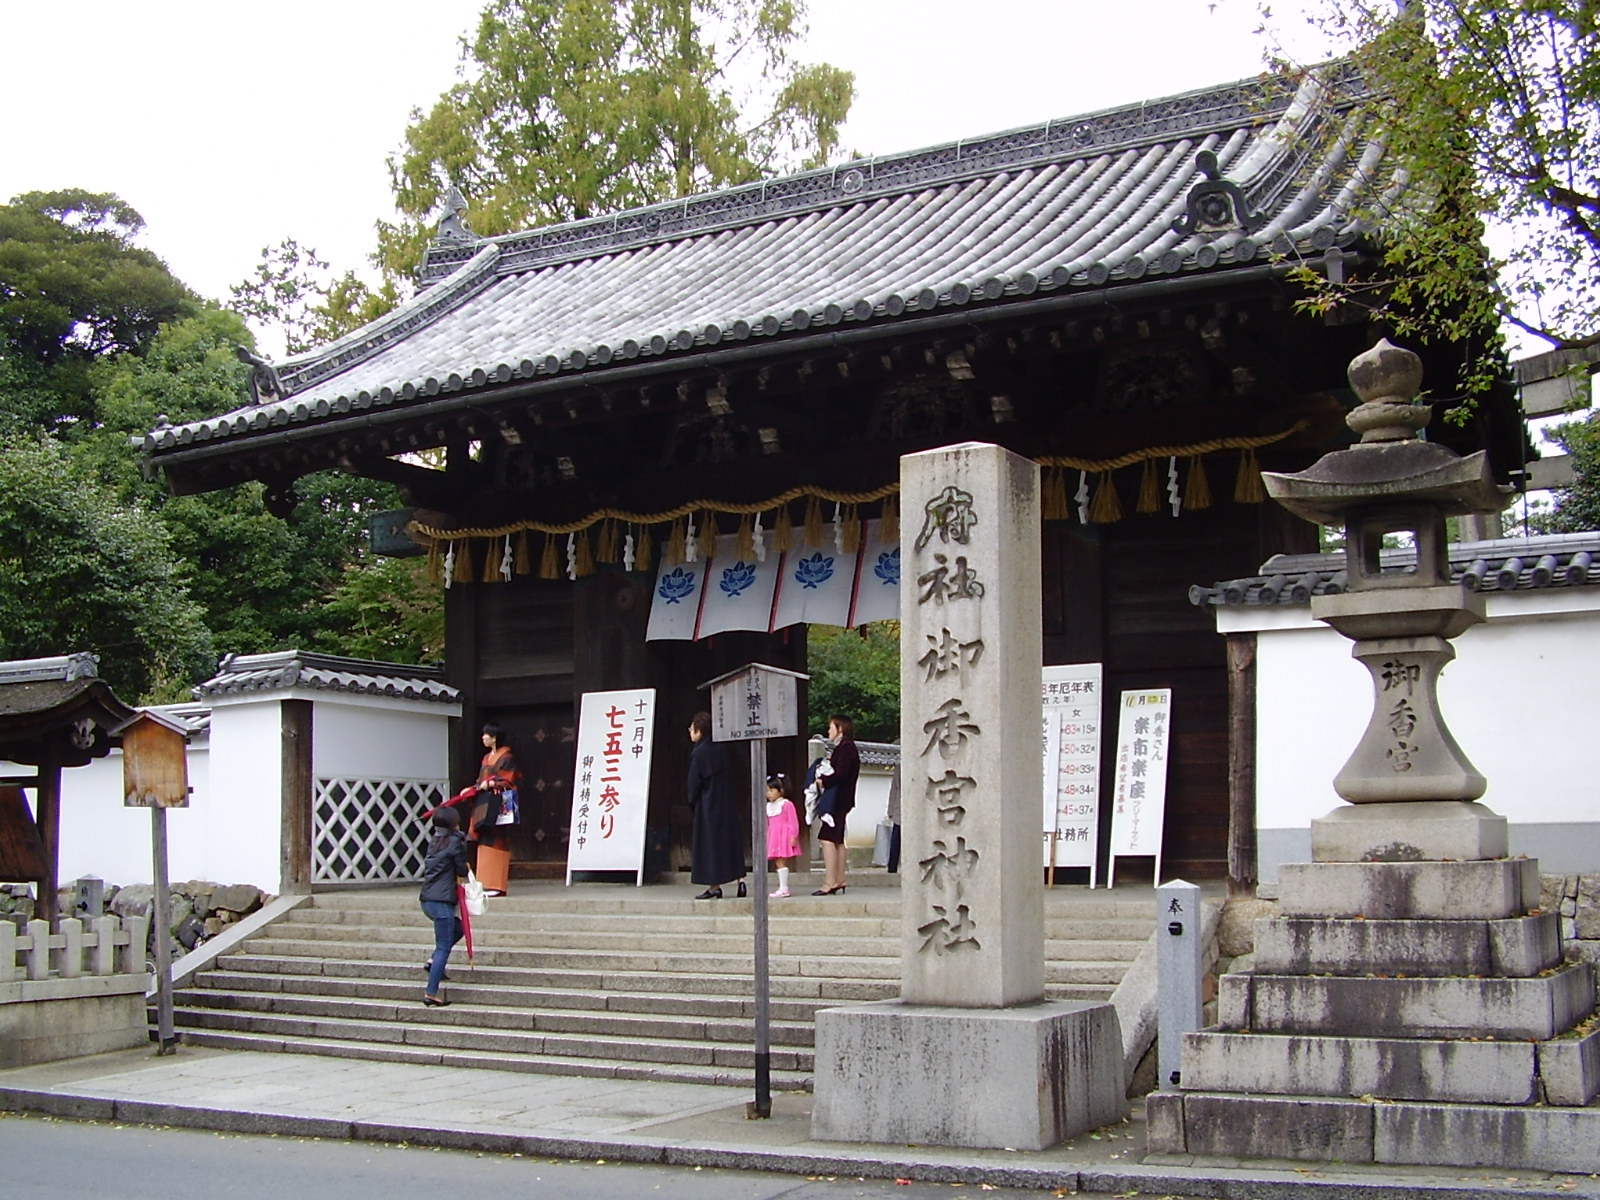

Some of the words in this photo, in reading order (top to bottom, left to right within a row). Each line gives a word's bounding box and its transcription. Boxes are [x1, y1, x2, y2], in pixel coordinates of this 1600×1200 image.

[631, 699, 648, 759] 十一月中
[744, 728, 778, 737] SMOKING
[746, 691, 761, 727] 禁止
[1382, 659, 1420, 772] 御香宮
[598, 705, 626, 839] 七五三参り
[1168, 898, 1183, 915] 奉
